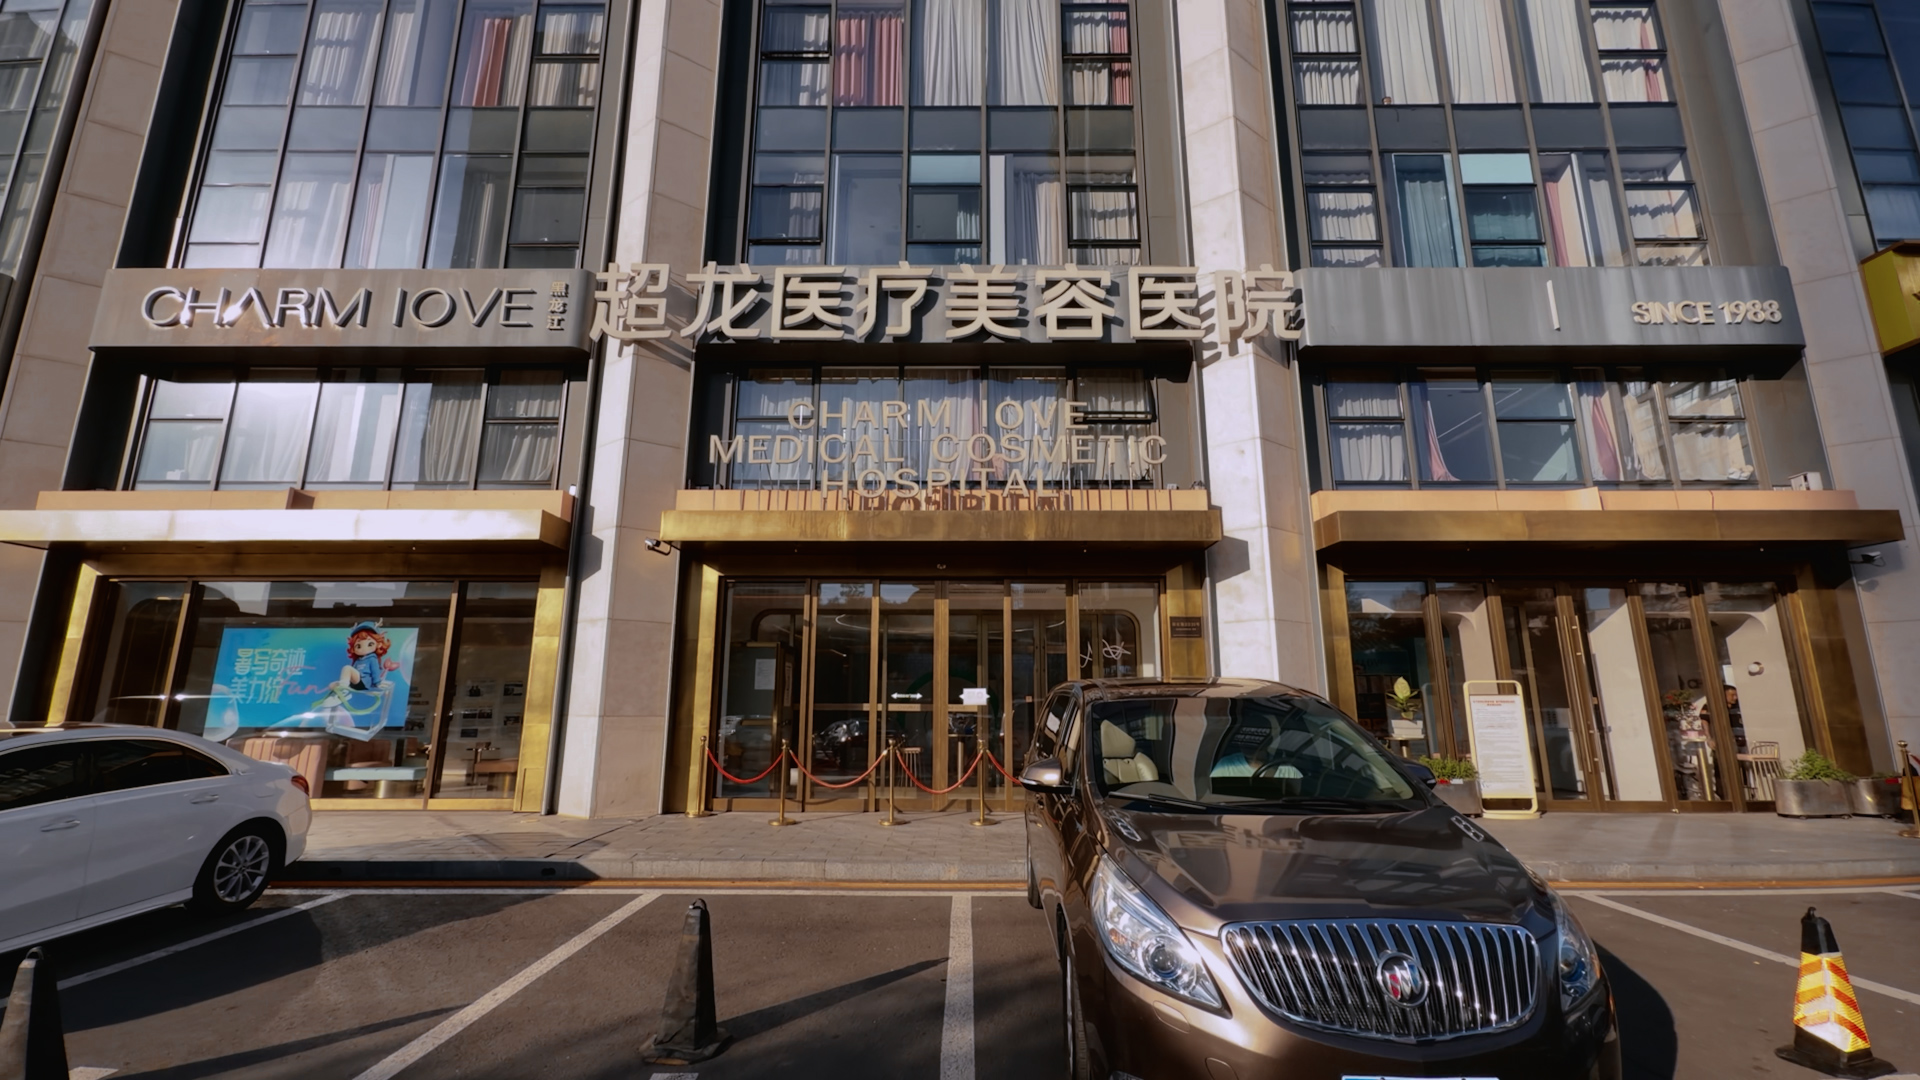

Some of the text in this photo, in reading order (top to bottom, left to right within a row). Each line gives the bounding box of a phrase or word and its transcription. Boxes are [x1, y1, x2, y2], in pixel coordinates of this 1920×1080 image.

[141, 286, 373, 330] CHARM
[546, 281, 569, 331] 黑龙江
[590, 261, 1302, 344] 超龙医疗美容医院
[1631, 300, 1783, 325] SINCE 1988
[787, 400, 950, 430] CHARM
[709, 433, 1168, 465] MEDICAL COSMETIC
[822, 468, 1059, 498] HOSPITAL
